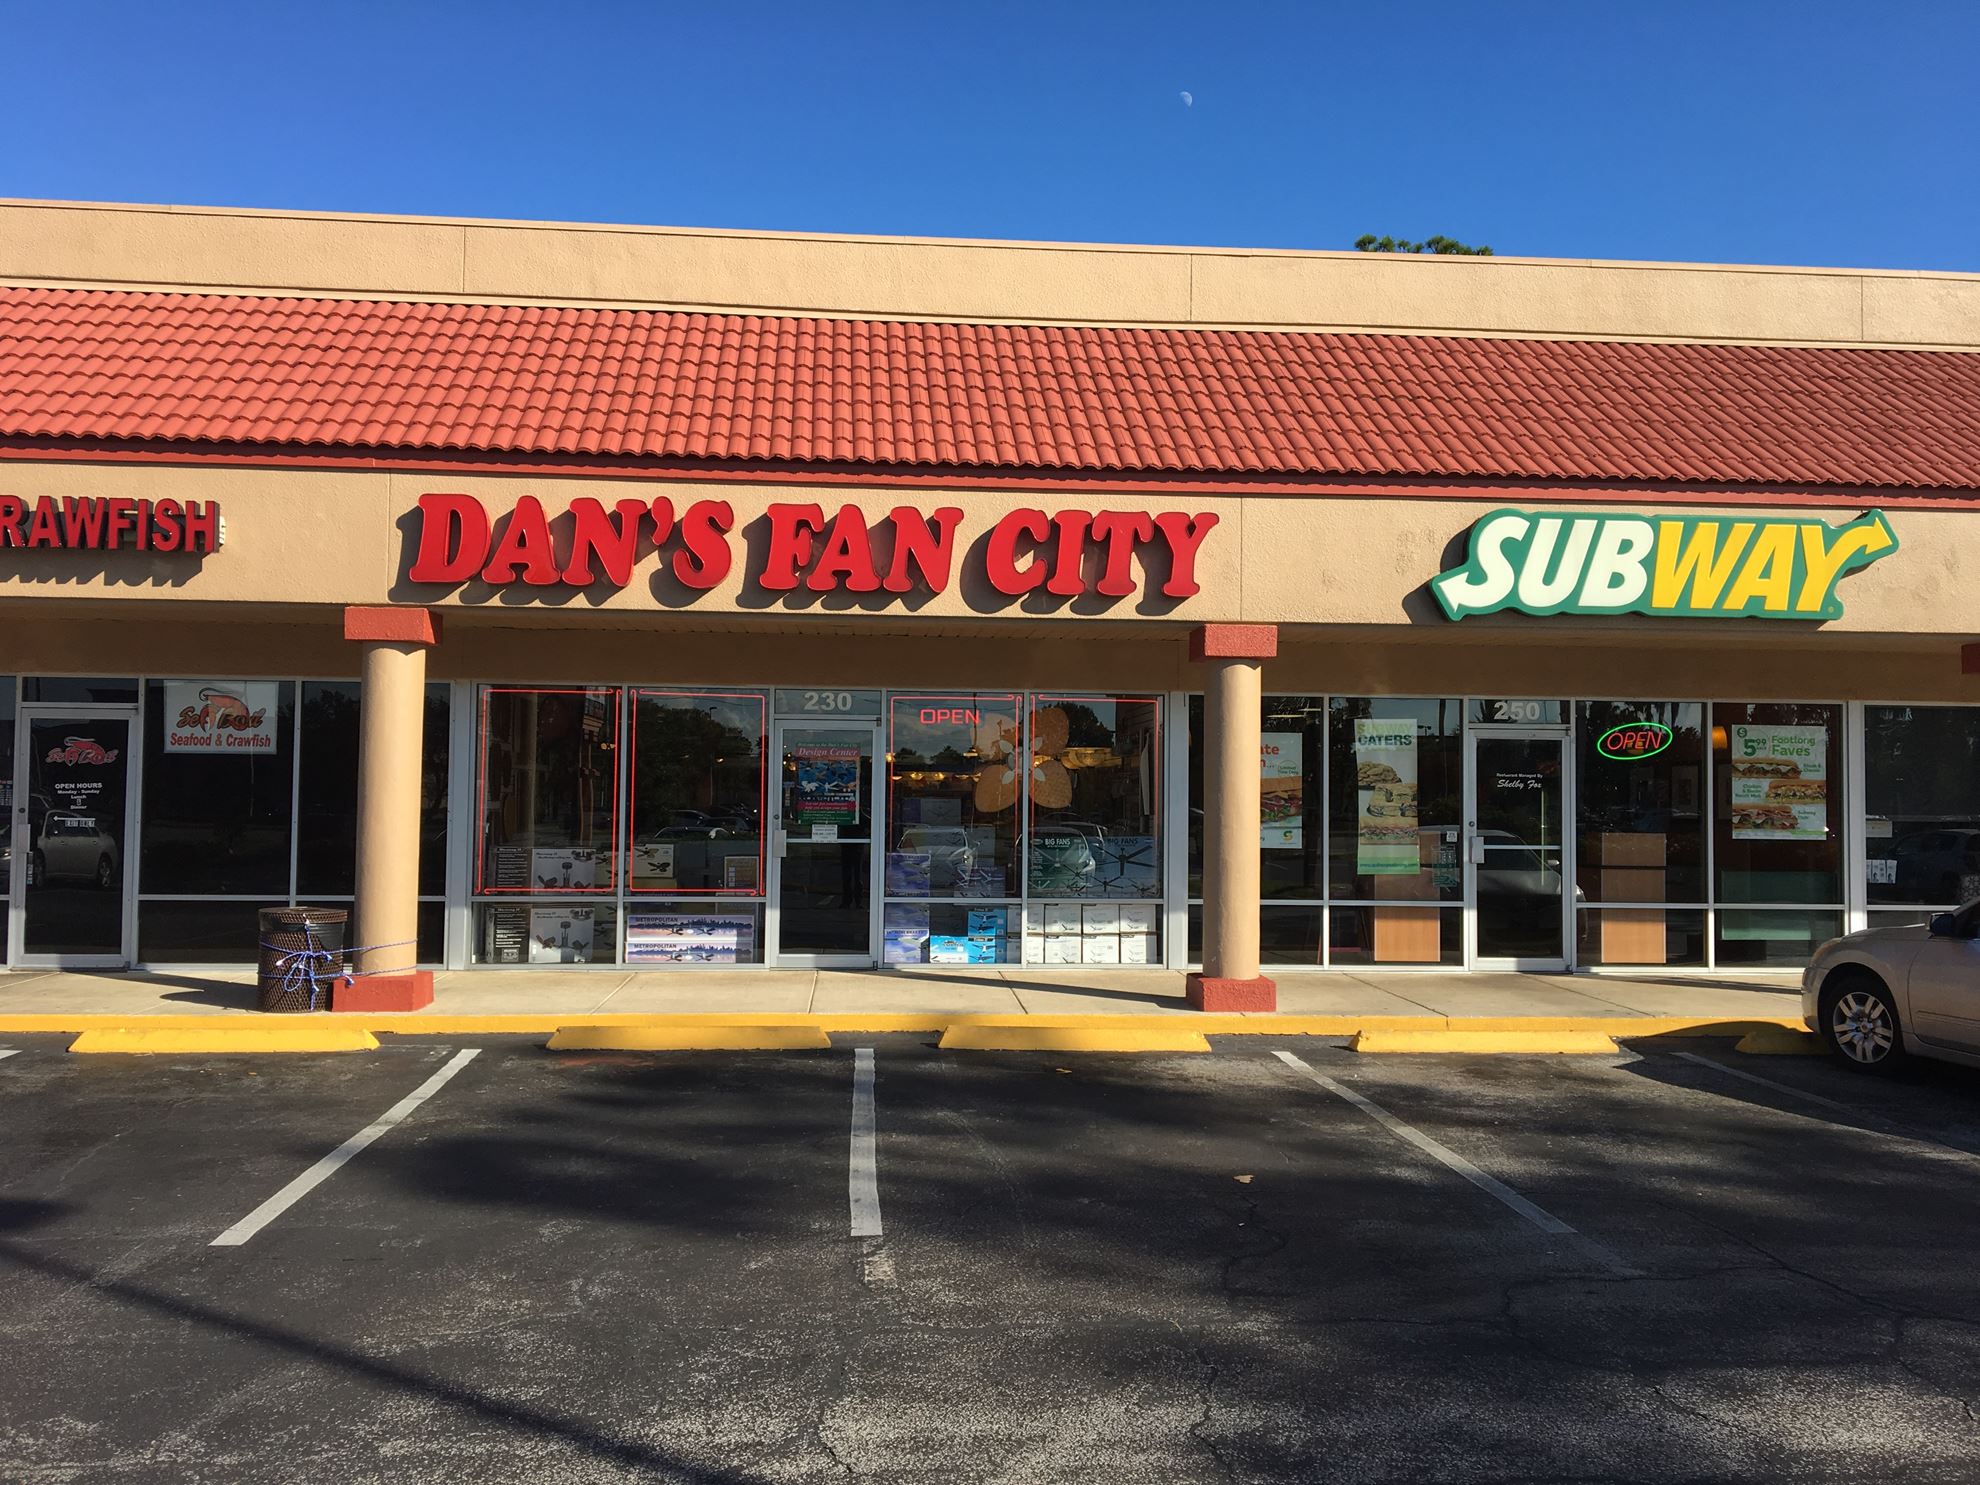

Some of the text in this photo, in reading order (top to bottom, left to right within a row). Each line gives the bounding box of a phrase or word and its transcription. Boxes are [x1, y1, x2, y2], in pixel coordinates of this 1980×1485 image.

[409, 492, 1221, 598] DAN'S FAN CITY
[1437, 514, 1893, 614] SUBWAY
[803, 691, 852, 711] 230
[919, 708, 981, 725] OPEN
[1493, 701, 1541, 721] 250
[170, 732, 271, 747] Seafood & Crawfish
[1357, 734, 1413, 746] CATERS
[1606, 730, 1663, 751] OPEN
[1771, 735, 1816, 747] Footlong
[798, 747, 858, 758] Design Center
[1771, 745, 1811, 756] Faves
[76, 782, 103, 790] HOURS
[1497, 779, 1543, 790] Shelby Fox
[1044, 838, 1071, 846] BIG FANS
